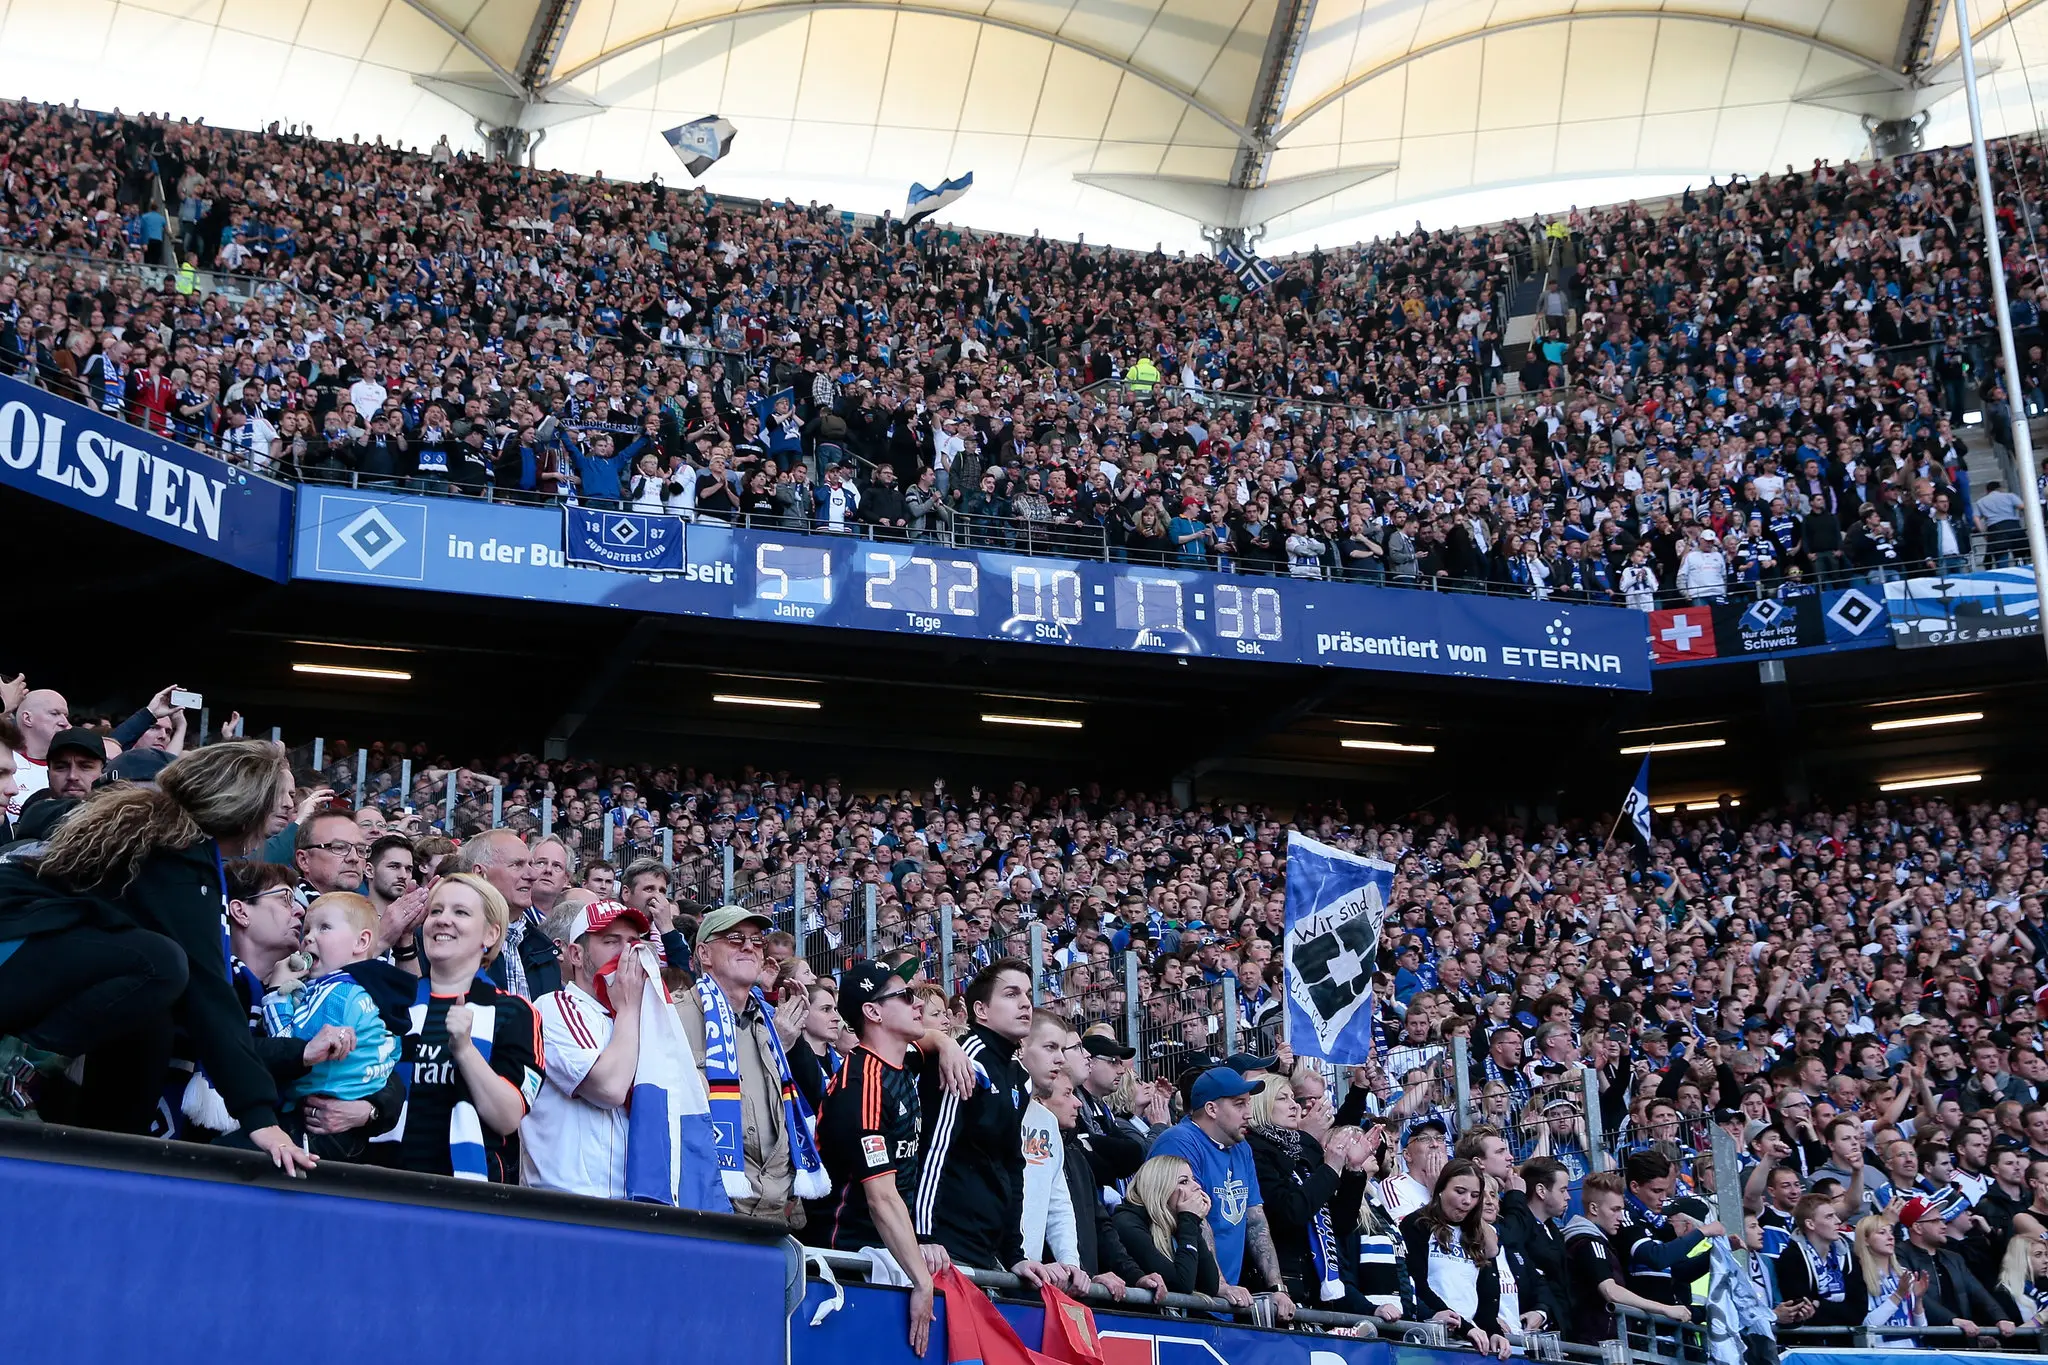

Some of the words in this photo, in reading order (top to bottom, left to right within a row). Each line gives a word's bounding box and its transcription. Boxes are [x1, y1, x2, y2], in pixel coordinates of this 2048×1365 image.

[0, 400, 227, 542] OLSTEN
[585, 520, 600, 533] 18
[650, 527, 665, 539] 87
[448, 534, 474, 560] in
[479, 537, 525, 564] der
[686, 560, 734, 585] seit
[585, 538, 642, 563] SUPPORTERS
[644, 544, 666, 560] CLUB
[865, 551, 978, 617] 272
[774, 602, 815, 618] Jahre
[906, 613, 941, 633] Tage
[1035, 623, 1062, 639] Std.
[1741, 631, 1757, 640] Nur
[1760, 627, 1775, 638] der
[1777, 625, 1797, 634] HSV
[1138, 631, 1166, 647] Min.
[1236, 640, 1265, 655] Sek.
[1317, 630, 1439, 660] präsentiert
[1446, 643, 1487, 663] von
[1743, 636, 1798, 651] Schweiz
[1501, 646, 1622, 674] ETERNA
[1295, 914, 1333, 942] Wir
[1340, 889, 1369, 921] sind
[718, 1001, 729, 1024] HSV
